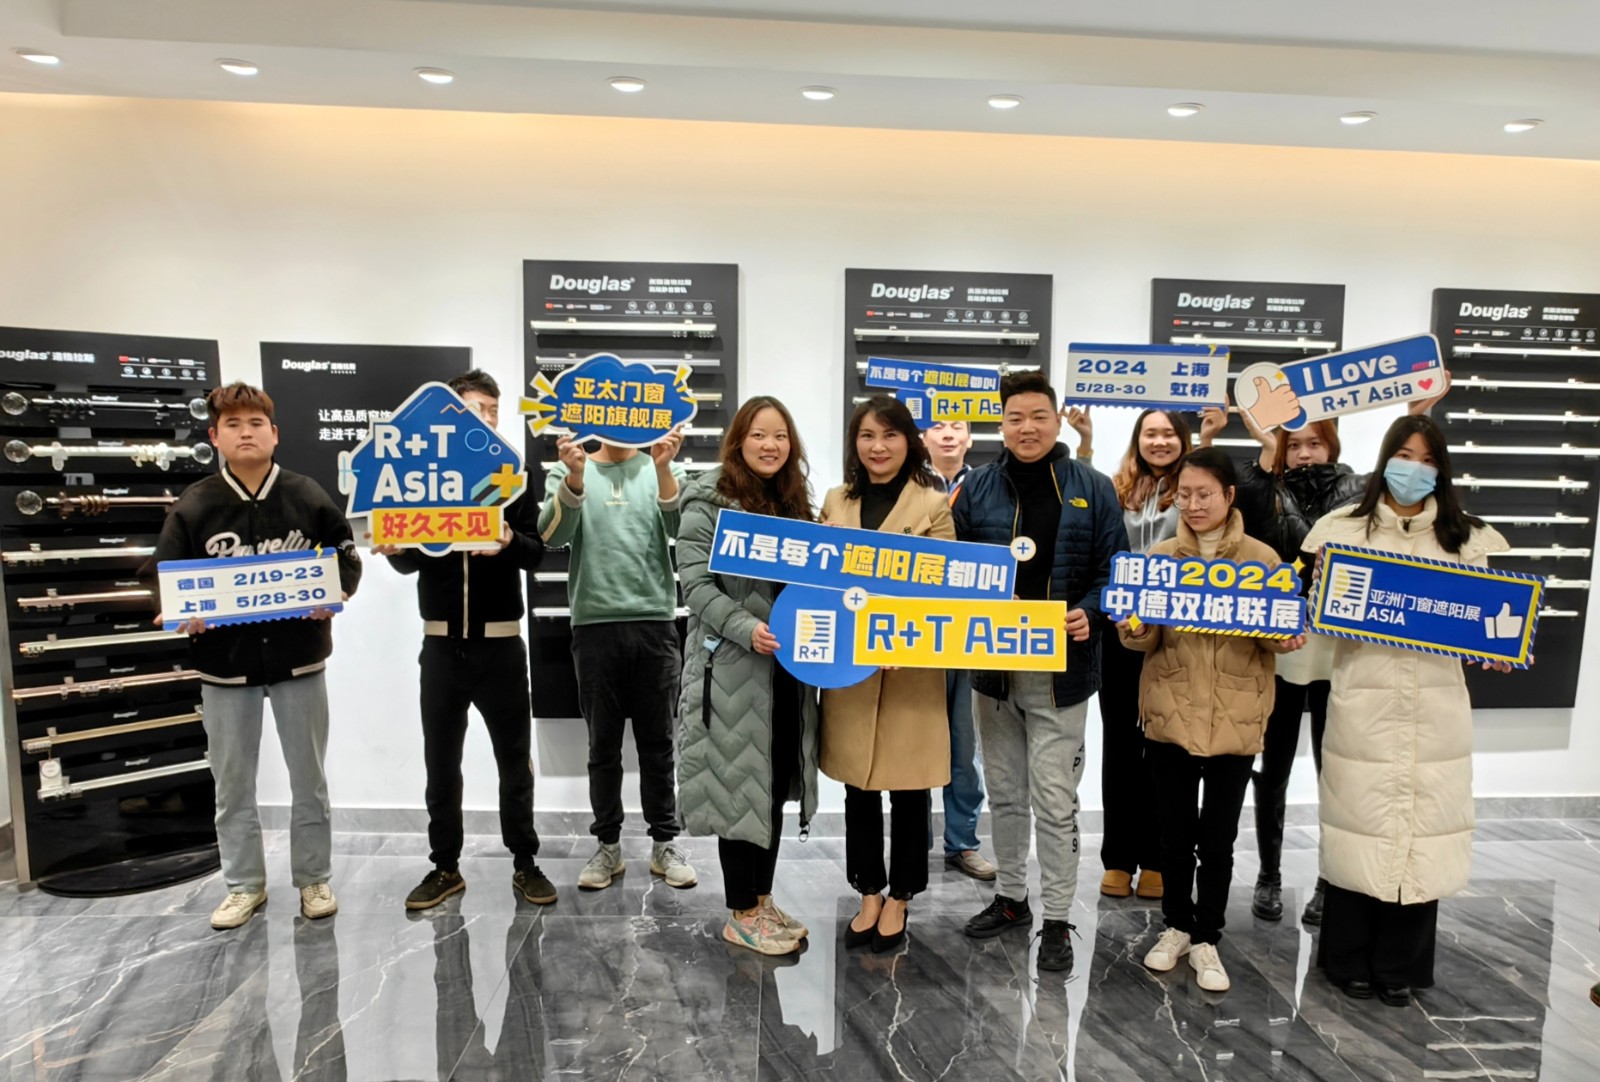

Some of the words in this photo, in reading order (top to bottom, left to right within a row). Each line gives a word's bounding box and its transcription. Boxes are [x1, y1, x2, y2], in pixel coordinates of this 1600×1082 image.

[549, 274, 632, 295] Douglas
[870, 283, 951, 303] Douglas
[1177, 292, 1252, 312] Douglas
[1458, 302, 1529, 322] Douglas
[0, 349, 48, 361] ouglas
[281, 359, 329, 372] Douglas
[1078, 359, 1148, 376] 2024
[1171, 362, 1210, 377] 上海
[1302, 366, 1315, 392] I
[1321, 354, 1398, 388] Love
[572, 377, 665, 404] 亚太门窗
[1075, 382, 1146, 395] 5/28-30
[1170, 382, 1210, 397] 虹桥
[1321, 390, 1360, 413] R+T
[1368, 381, 1413, 404] Asia
[560, 402, 673, 430] 遮阳旗舰展
[937, 399, 973, 415] R+T
[979, 399, 1002, 415] As
[374, 424, 456, 459] R+T
[372, 463, 464, 503] Asia
[382, 511, 491, 539] 好久不见
[719, 529, 1007, 592] 不是每个遮阳展都叫
[177, 576, 215, 591] 德国
[233, 565, 324, 586] 2/19-23
[1114, 556, 1296, 592] 相约2024
[180, 599, 217, 613] 上海
[236, 587, 326, 608] 5/28-30
[1105, 586, 1300, 630] 中德双城联展
[1330, 599, 1361, 617] R+T
[1369, 588, 1482, 622] 亚洲门窗遮阳展
[1366, 607, 1406, 627] ASIA
[867, 612, 953, 653] R+T
[964, 616, 1055, 655] Asia
[799, 645, 829, 660] R+T
